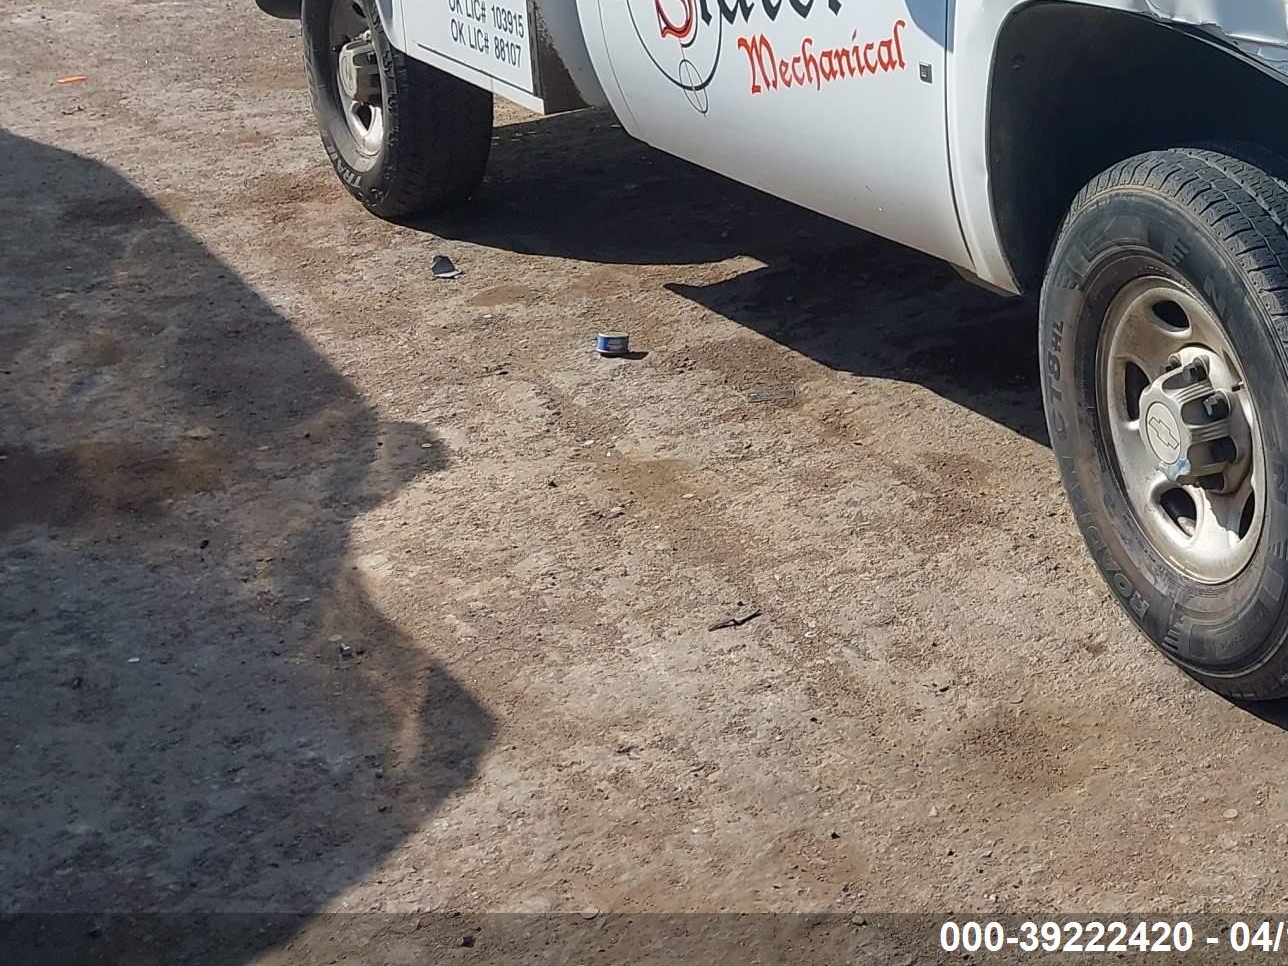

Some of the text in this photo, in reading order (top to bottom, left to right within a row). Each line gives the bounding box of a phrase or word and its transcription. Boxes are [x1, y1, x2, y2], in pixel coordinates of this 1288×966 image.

[451, 18, 522, 69] OK LIC# 88107
[491, 4, 525, 39] 103915
[737, 19, 905, 95] Mechanical
